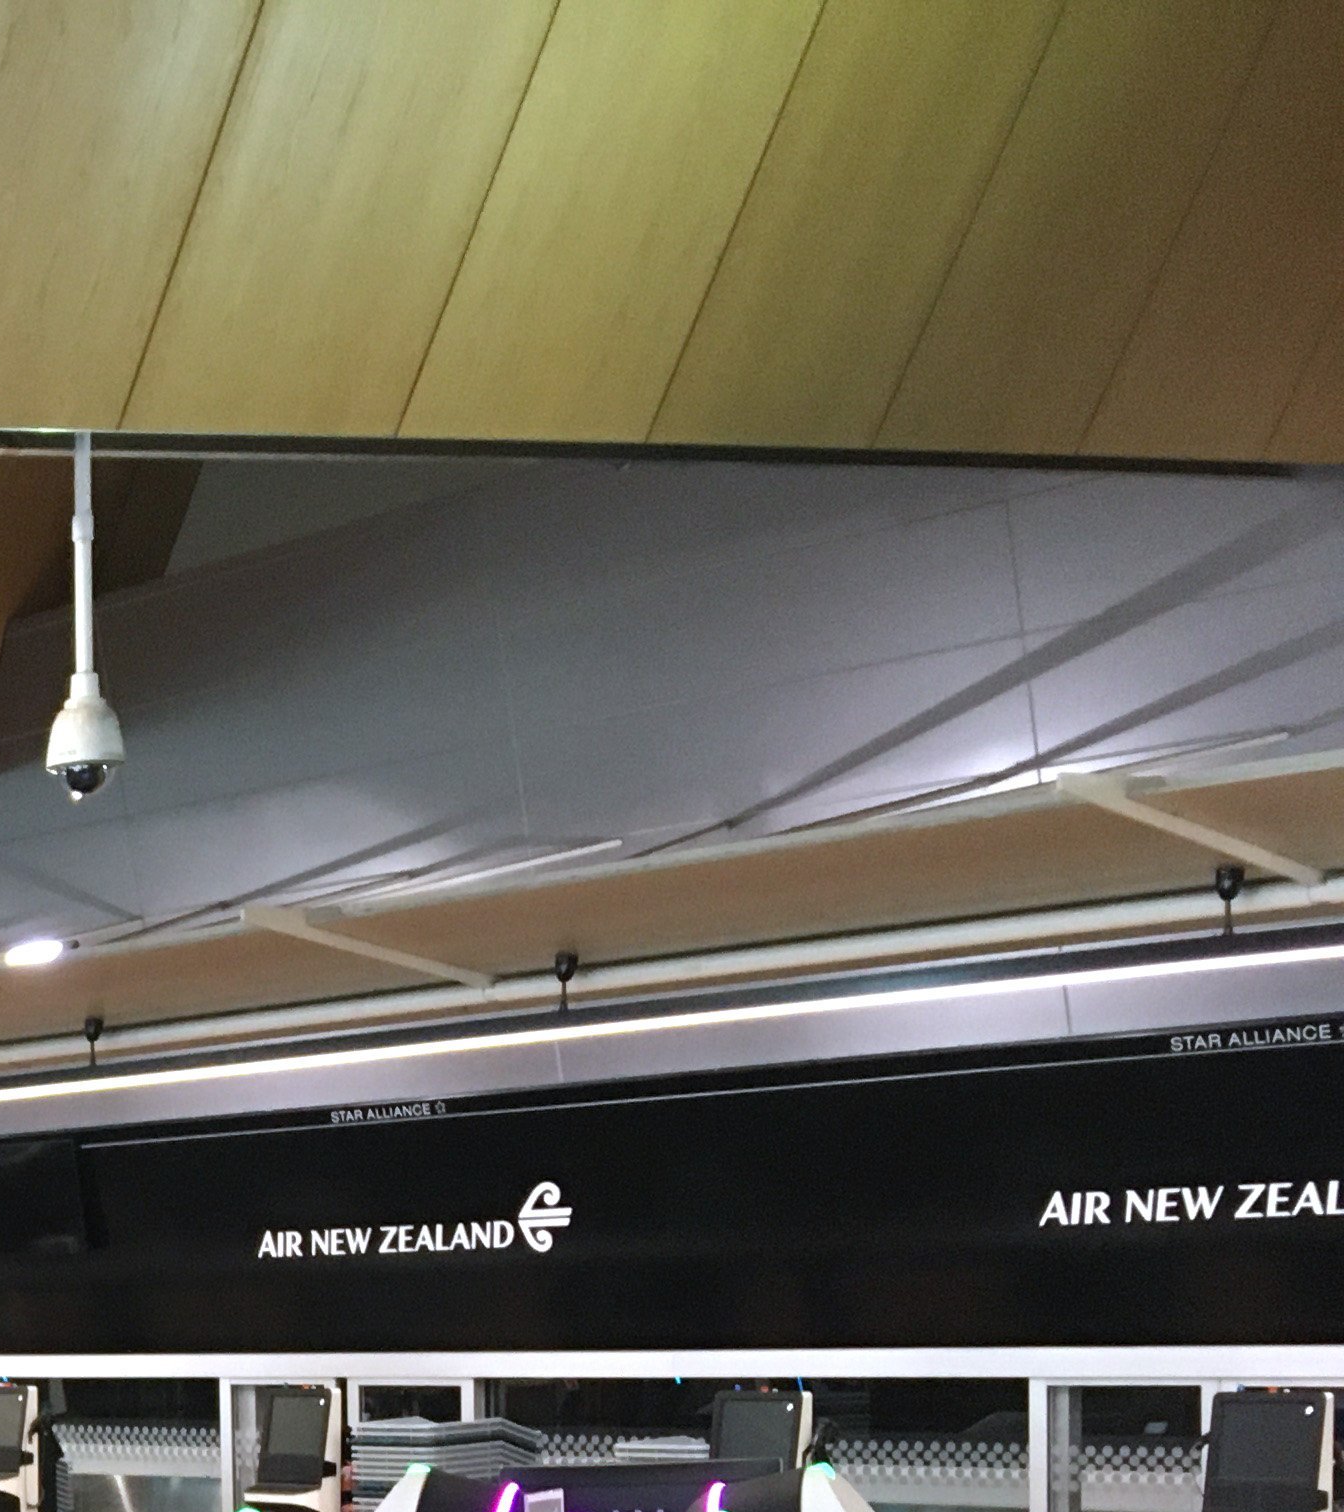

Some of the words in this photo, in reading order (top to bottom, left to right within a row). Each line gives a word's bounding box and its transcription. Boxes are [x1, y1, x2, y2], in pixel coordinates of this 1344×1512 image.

[1170, 1034, 1222, 1053] STAR
[1228, 1024, 1332, 1049] ALLIANCE
[330, 1107, 364, 1124] STAR
[366, 1102, 432, 1121] ALLIANCE
[1039, 1191, 1111, 1227] AIR
[1124, 1186, 1223, 1223] NEW
[258, 1230, 302, 1258] AIR
[311, 1227, 371, 1256] NEW
[378, 1220, 514, 1254] ZEALAND
